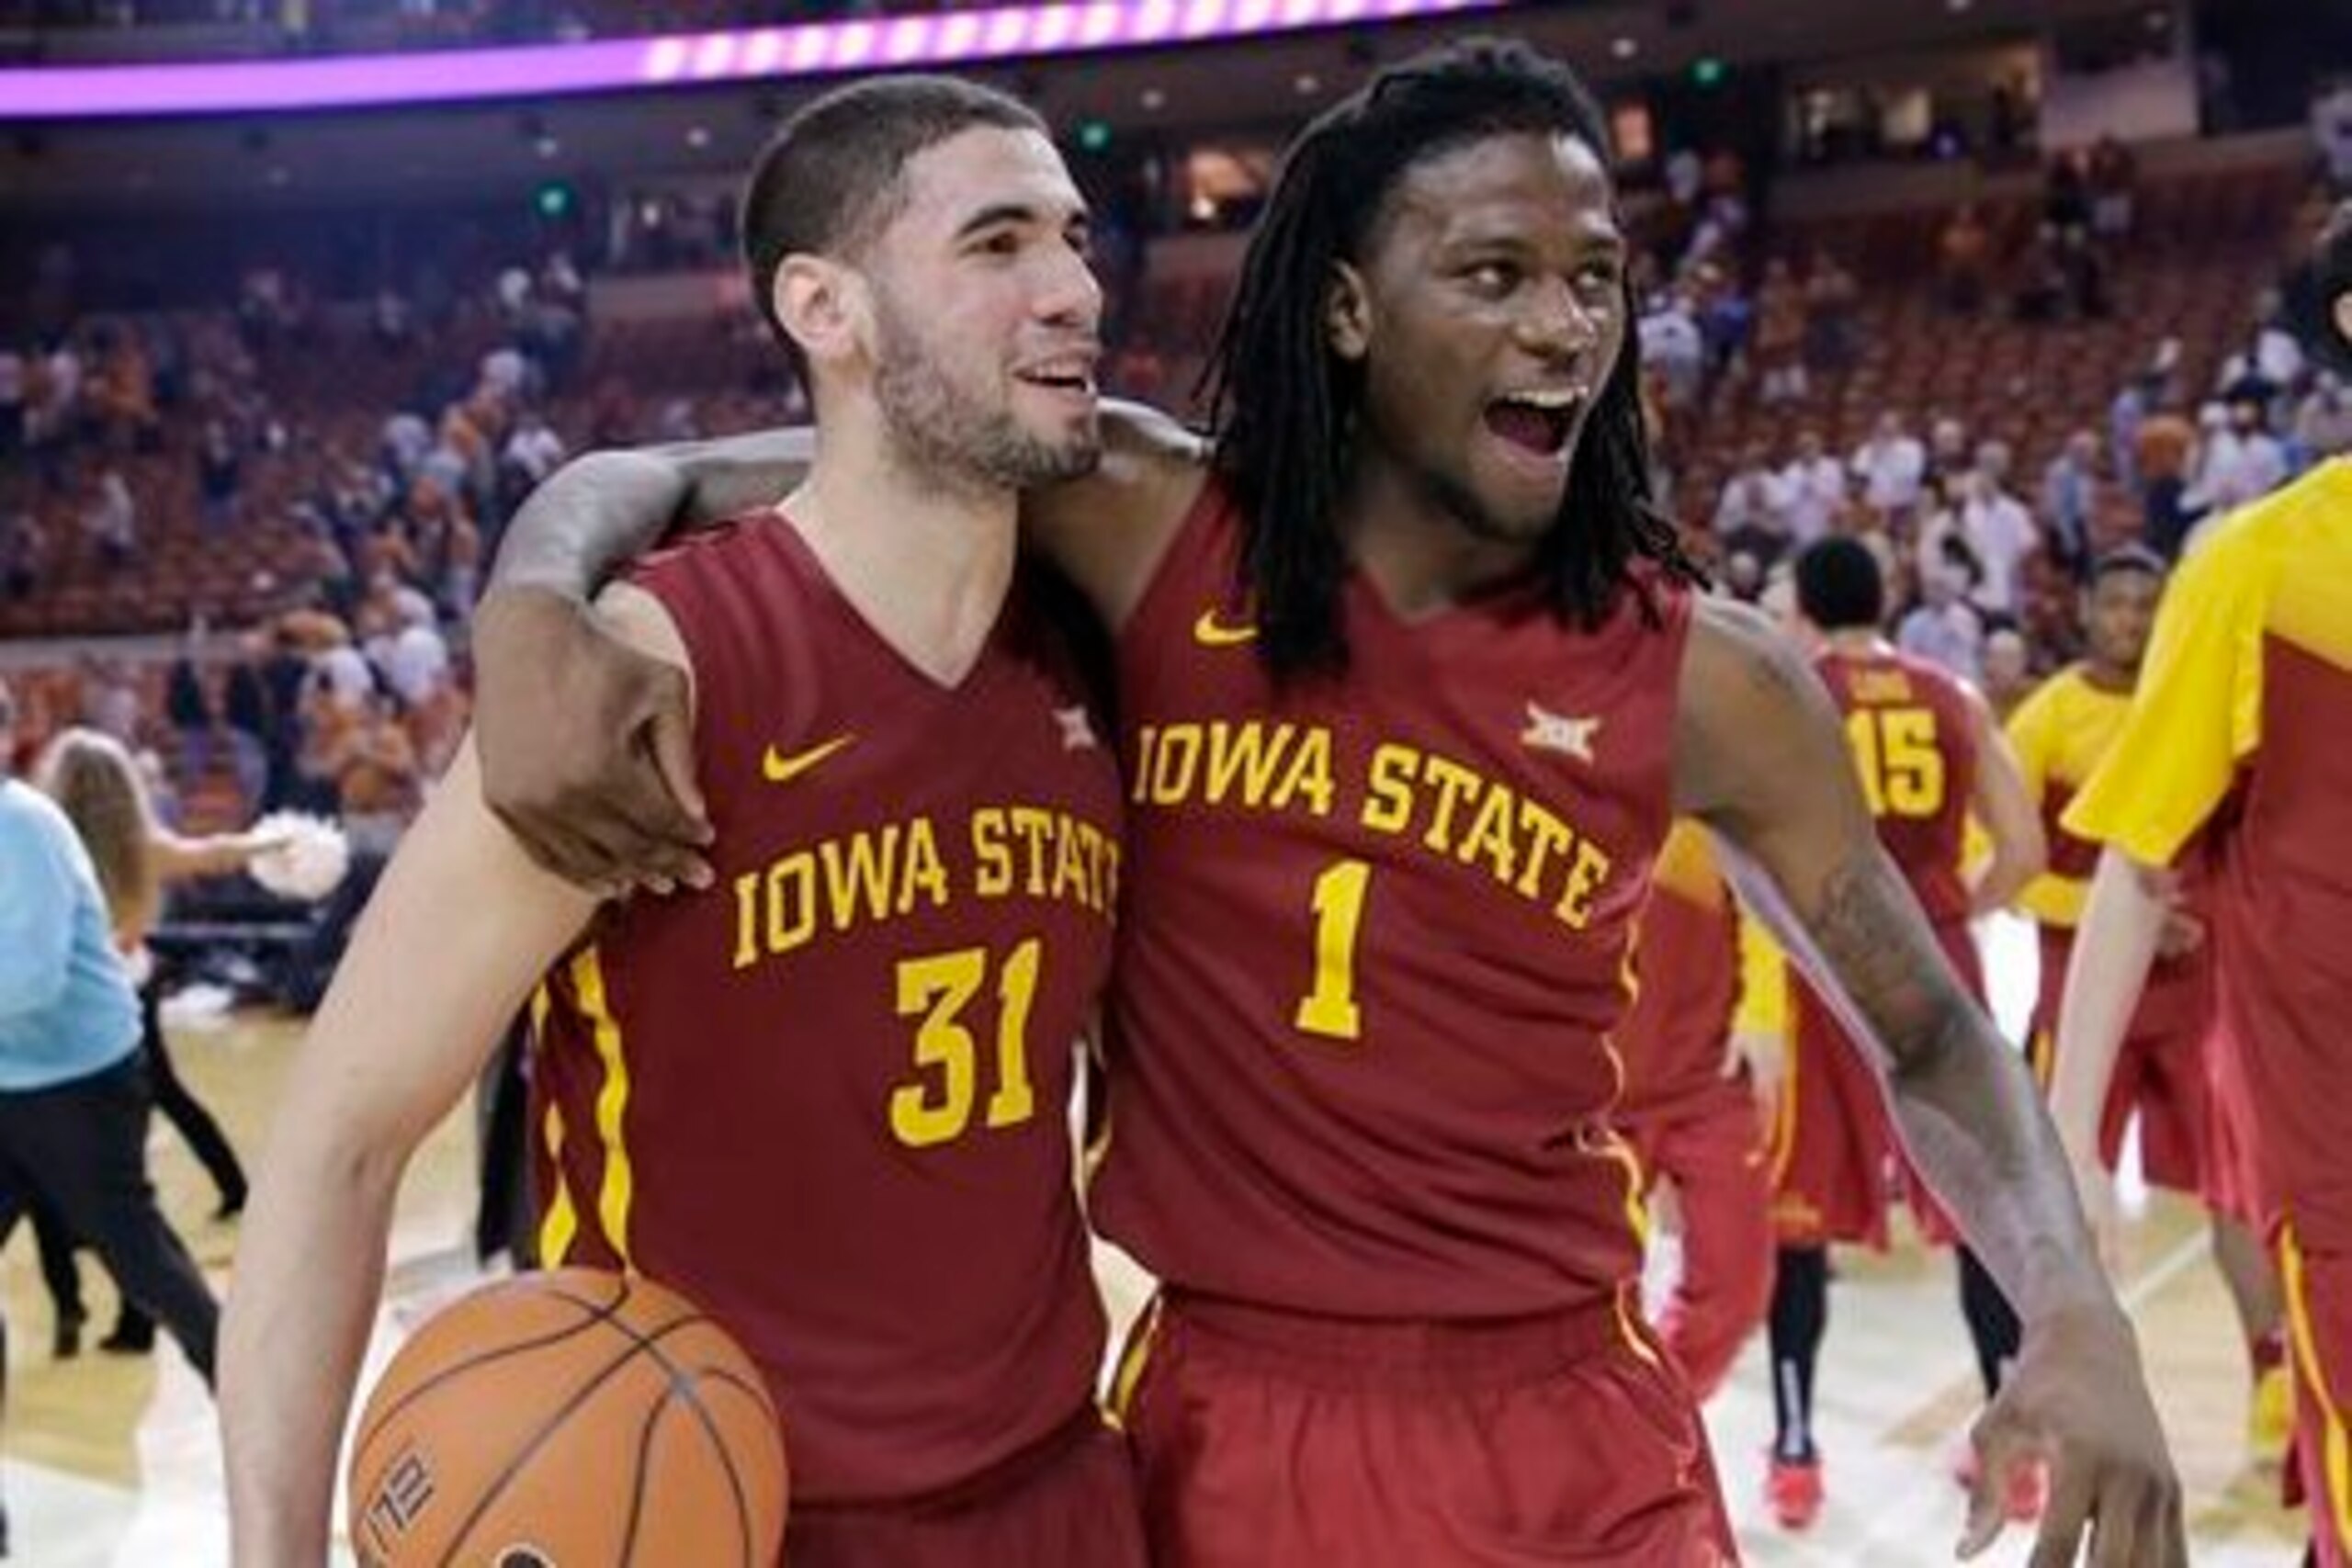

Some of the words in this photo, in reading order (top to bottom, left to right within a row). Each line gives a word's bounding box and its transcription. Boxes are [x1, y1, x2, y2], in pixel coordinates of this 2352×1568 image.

[1132, 722, 1334, 816] IOWA
[1361, 743, 1610, 930] STATE
[1849, 708, 1944, 816] 15
[734, 818, 948, 968] IOWA
[1295, 859, 1372, 1038] 1
[890, 938, 1040, 1145] 31
